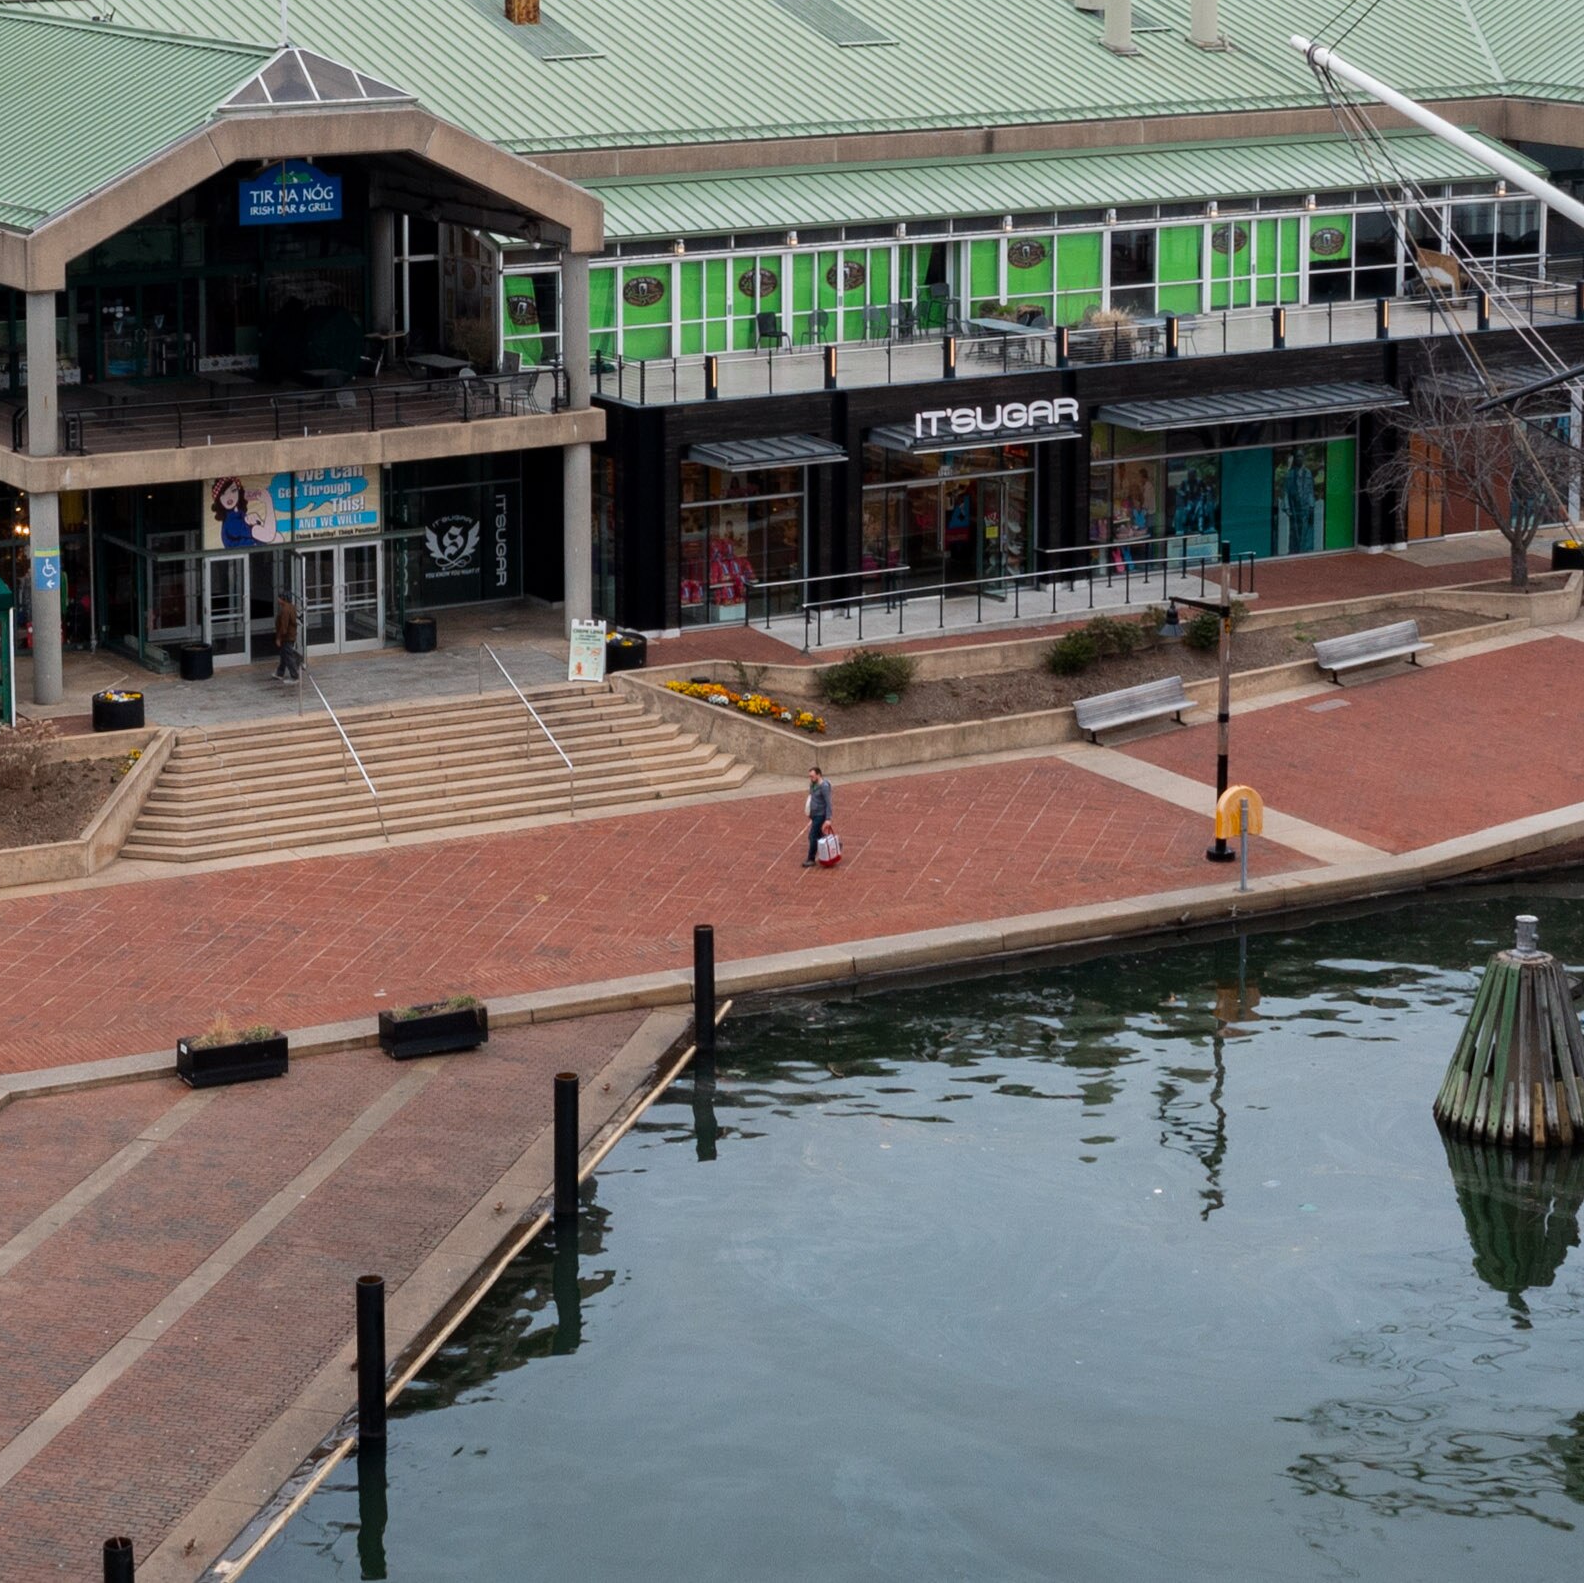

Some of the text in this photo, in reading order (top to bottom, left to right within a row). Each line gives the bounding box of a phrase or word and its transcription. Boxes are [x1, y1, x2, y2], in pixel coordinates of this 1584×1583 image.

[249, 190, 275, 204] TIR
[278, 188, 299, 203] NA
[249, 202, 334, 216] IRISH BAR & GRILL
[915, 397, 1079, 439] IT'SUGAR
[303, 480, 351, 497] Through
[332, 495, 365, 512] This!
[299, 516, 317, 530] AND
[320, 515, 334, 528] WE
